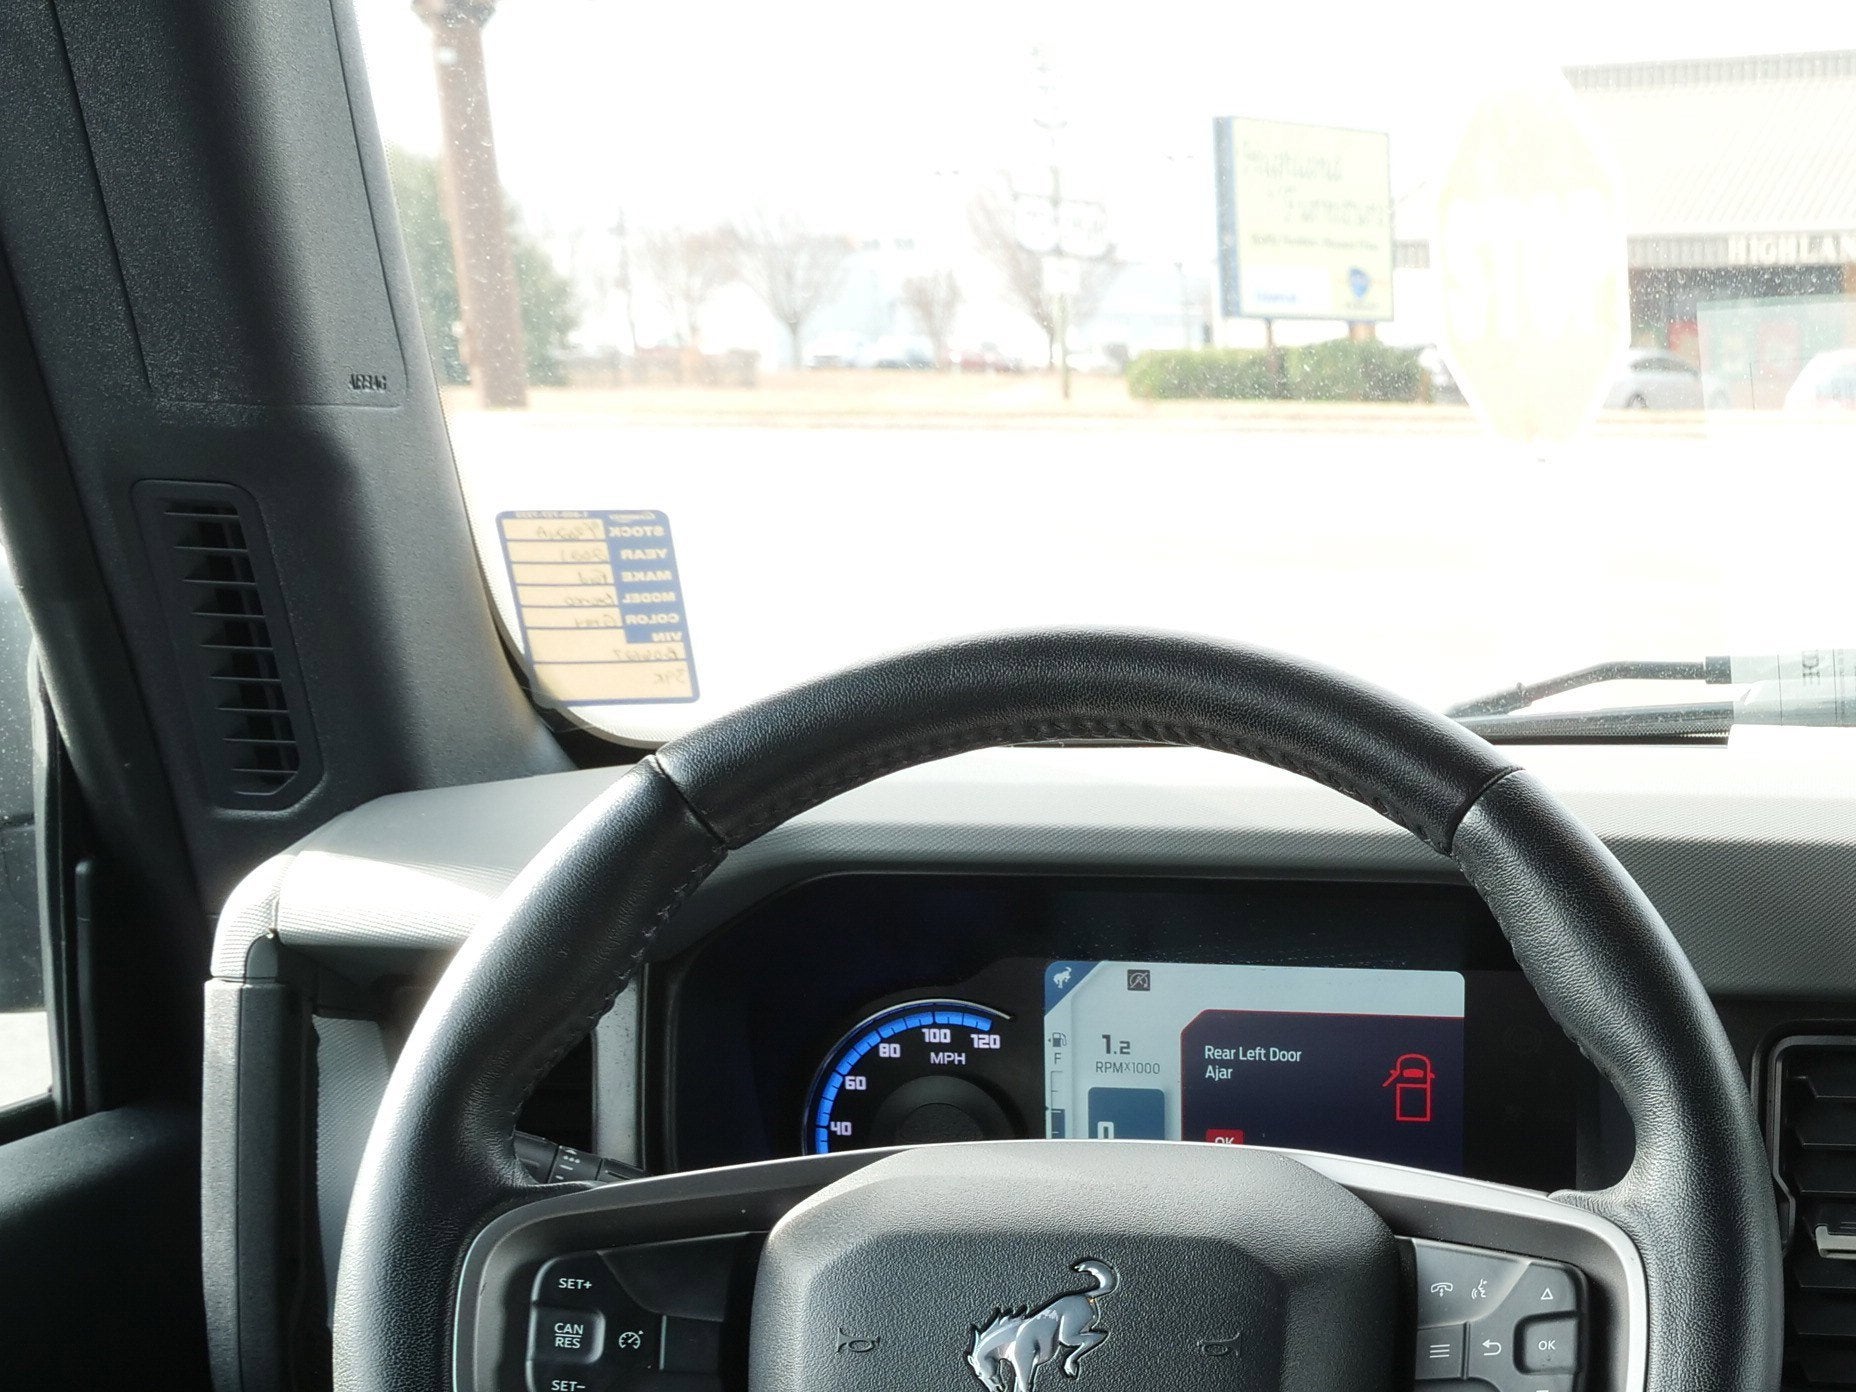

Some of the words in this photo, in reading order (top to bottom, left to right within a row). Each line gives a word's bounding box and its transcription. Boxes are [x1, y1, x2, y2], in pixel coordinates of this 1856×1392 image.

[921, 1027, 951, 1044] 100
[970, 1033, 1001, 1050] 120
[878, 1042, 902, 1059] 80
[1101, 1034, 1131, 1055] 1.2
[929, 1051, 966, 1066] MPH
[1053, 1052, 1062, 1065] F
[1204, 1045, 1235, 1062] Rear
[1239, 1045, 1266, 1062] Left
[1270, 1047, 1302, 1063] Door
[1204, 1064, 1233, 1081] Ajar
[844, 1074, 867, 1092] 60
[829, 1120, 853, 1136] 40
[558, 1277, 593, 1290] SET+
[554, 1322, 584, 1335] CAN
[554, 1337, 581, 1349] RES
[1537, 1339, 1556, 1351] OK
